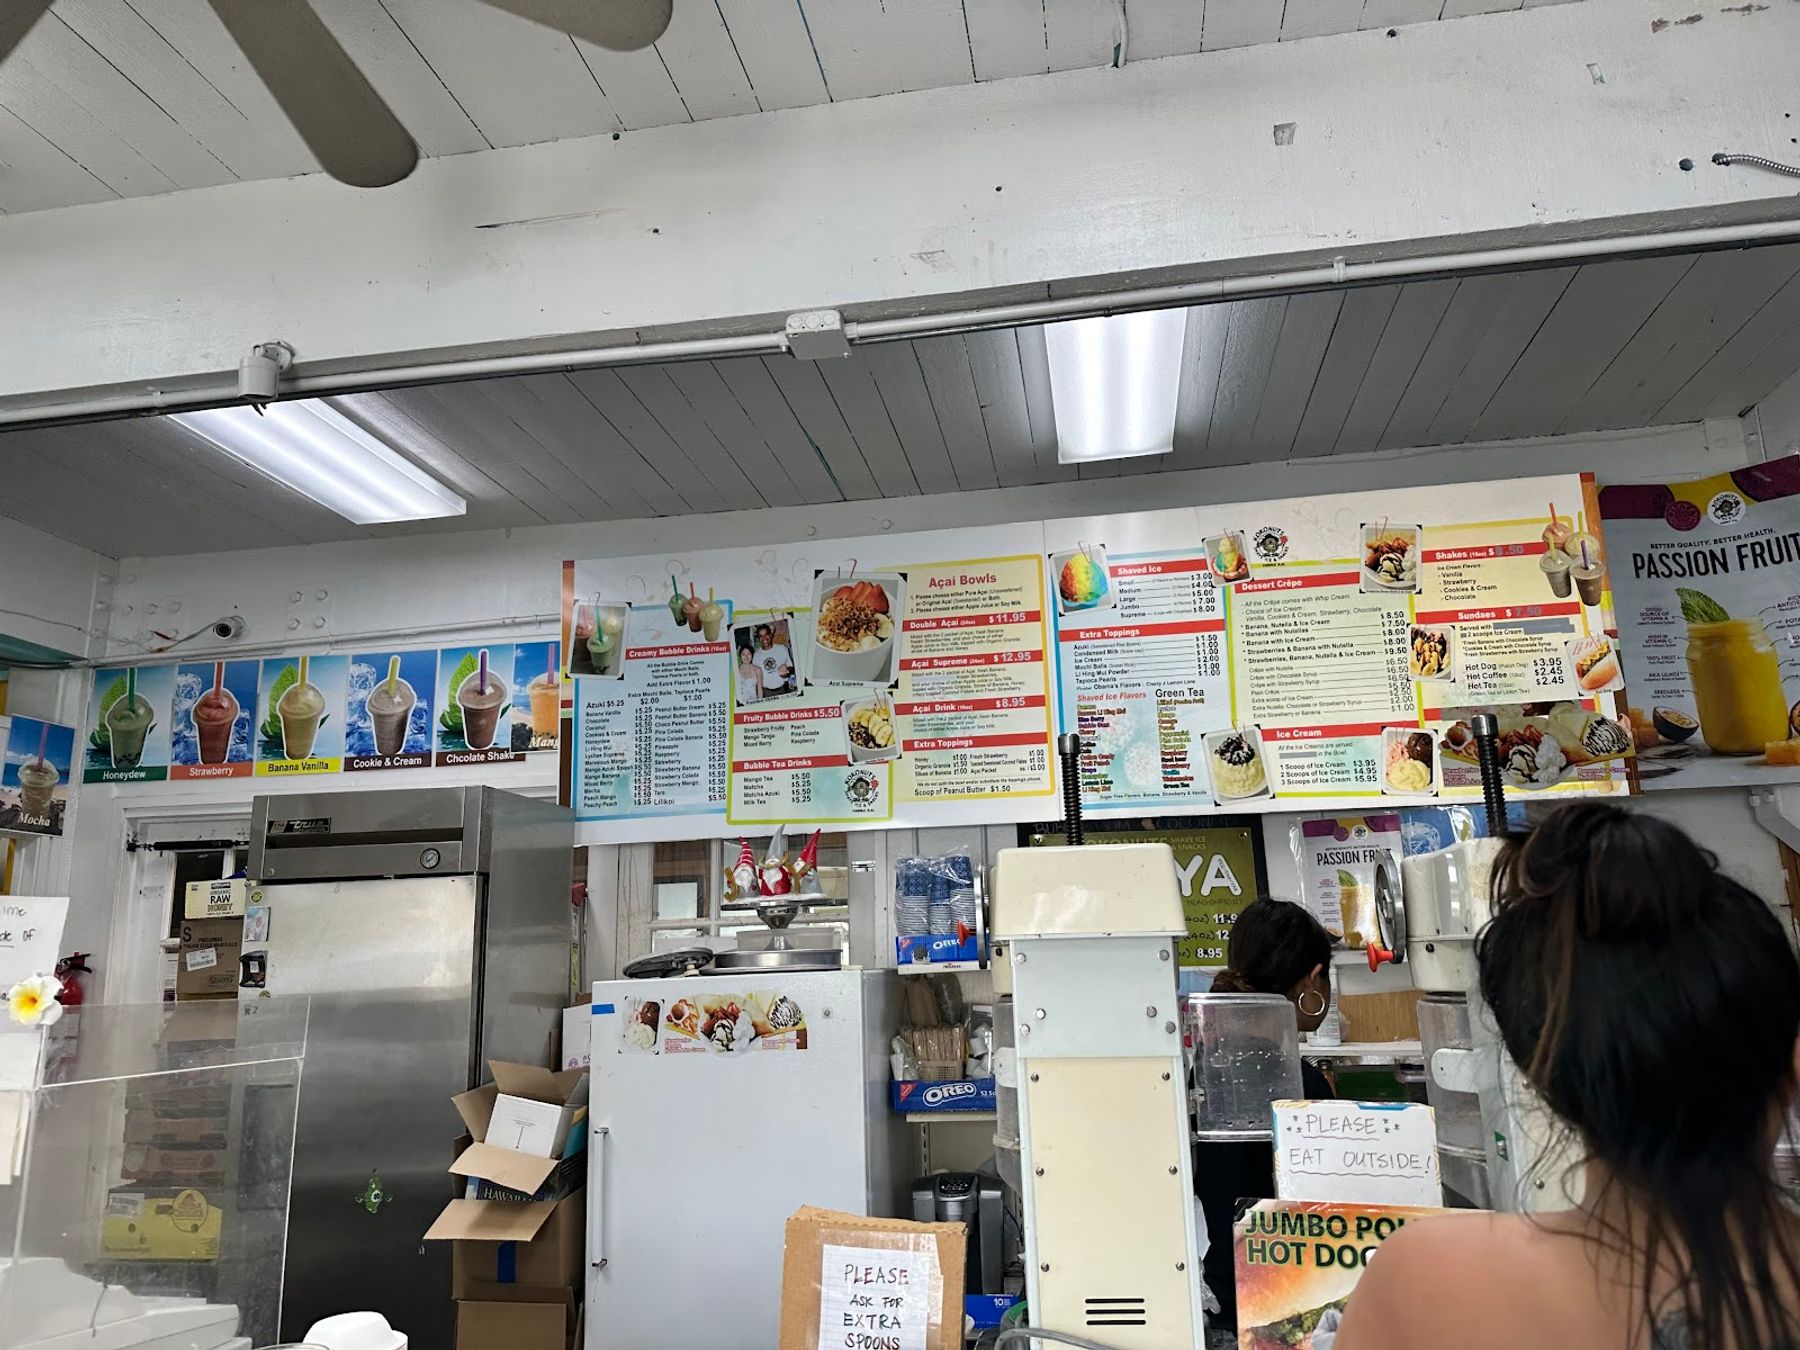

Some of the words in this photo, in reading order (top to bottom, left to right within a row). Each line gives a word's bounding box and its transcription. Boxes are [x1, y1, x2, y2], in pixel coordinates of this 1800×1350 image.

[1713, 535, 1742, 545] BETTER
[1435, 550, 1468, 560] Shakes
[1632, 548, 1729, 579] PASSION
[1736, 532, 1800, 571] FRUIT
[1117, 567, 1146, 575] Shaved
[1149, 565, 1162, 573] Ice
[960, 573, 997, 585] Bowls
[1242, 581, 1275, 591] Dessert
[1458, 611, 1496, 620] Sundaes
[910, 621, 937, 629] Double
[1104, 628, 1140, 638] Toppings
[629, 650, 657, 658] Creamy
[659, 647, 684, 656] Bubble
[933, 658, 967, 667] Supreme
[1465, 663, 1478, 671] Hot
[1480, 662, 1497, 671] Dog
[1077, 694, 1104, 702] Shaved
[1119, 691, 1147, 700] Flavors
[1155, 689, 1185, 698] Green
[1187, 688, 1205, 697] Tea
[743, 715, 764, 723] Fruity
[765, 713, 788, 721] Bubble
[1276, 730, 1291, 738] Ice
[1293, 729, 1322, 737] Cream
[938, 739, 973, 748] Toppings
[268, 763, 300, 773] Banana
[302, 761, 329, 771] Vanilla
[353, 758, 383, 768] Cookie
[384, 758, 392, 767] &
[393, 757, 422, 766] Cream
[743, 762, 769, 770] Bubble
[787, 760, 812, 768] Drinks
[103, 770, 146, 780] Honeydew
[189, 767, 234, 777] Strawberry
[914, 788, 935, 797] Scoop
[17, 812, 52, 828] Mocha
[1317, 851, 1360, 866] PASSION
[211, 895, 231, 904] RAW
[183, 927, 192, 942] S
[1196, 947, 1223, 959] 8.95
[925, 1084, 974, 1103] OREO
[1306, 1114, 1377, 1134] PLEASE
[1290, 1148, 1324, 1166] EAT
[1343, 1151, 1432, 1174] OUTSIDE!
[1245, 1211, 1347, 1239] JUMBO
[1247, 1238, 1307, 1265] HOT
[844, 1263, 909, 1285] PLEASE
[849, 1295, 874, 1307] ASK
[883, 1297, 904, 1308] FOR
[994, 1298, 1004, 1307] 10
[843, 1312, 902, 1330] EXTRA
[844, 1332, 901, 1350] SPOONS
